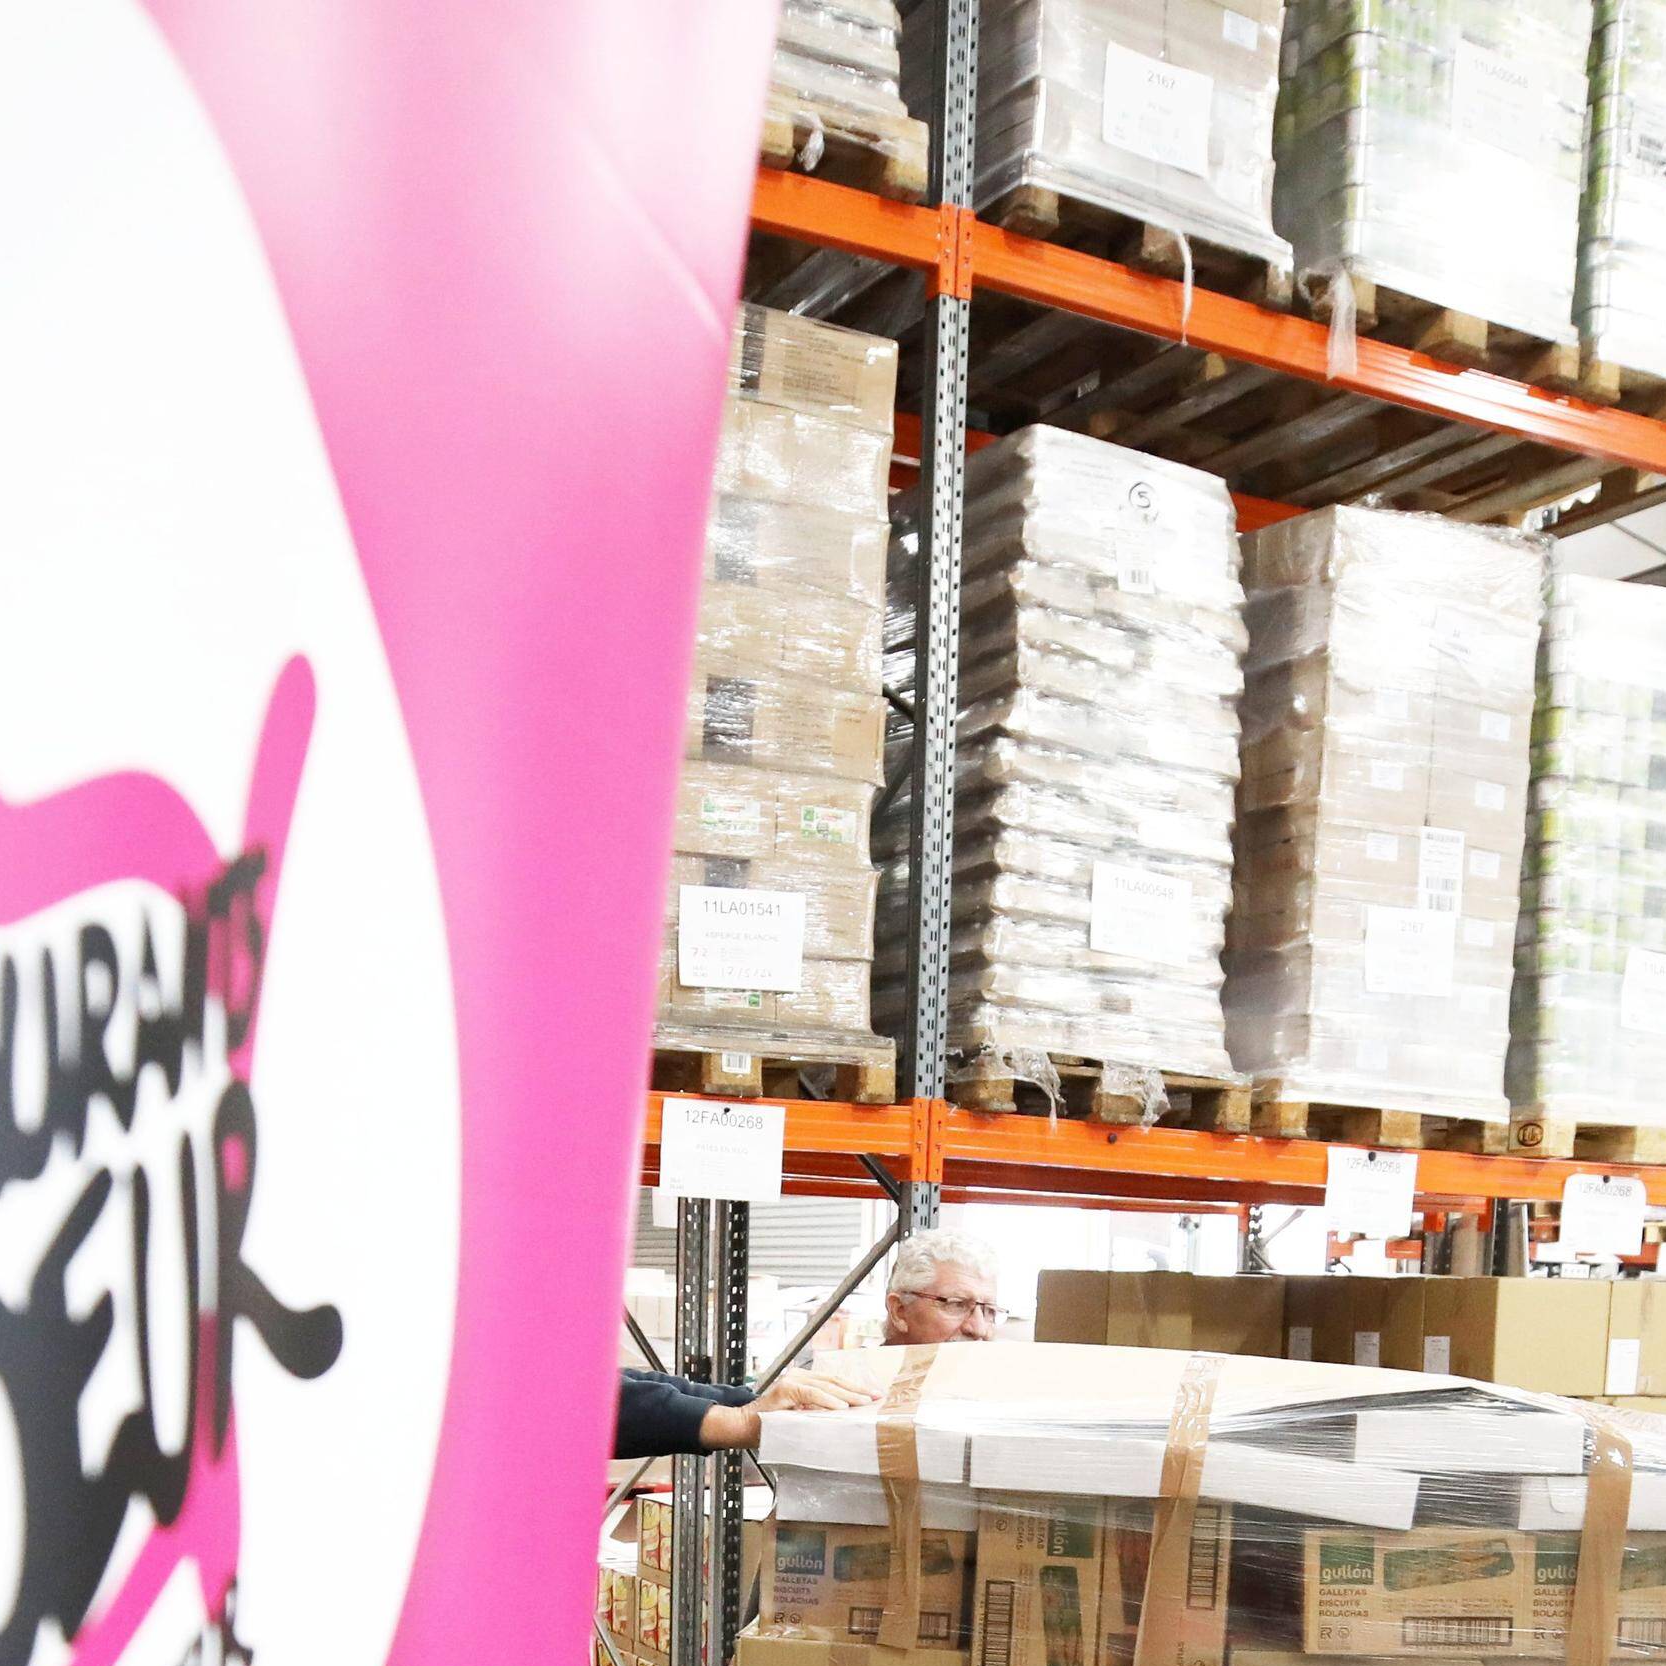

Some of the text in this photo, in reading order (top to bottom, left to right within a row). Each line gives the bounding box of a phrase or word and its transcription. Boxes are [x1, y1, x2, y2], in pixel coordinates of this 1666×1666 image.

[703, 900, 782, 918] 11LA01541
[684, 1109, 765, 1131] 12FA00268
[777, 1554, 824, 1572] gullón
[1321, 1563, 1373, 1582] gullón
[1318, 1587, 1368, 1597] GALLETAS
[1318, 1598, 1361, 1608] BISCUITS
[1318, 1608, 1370, 1618] BOLACHAS
